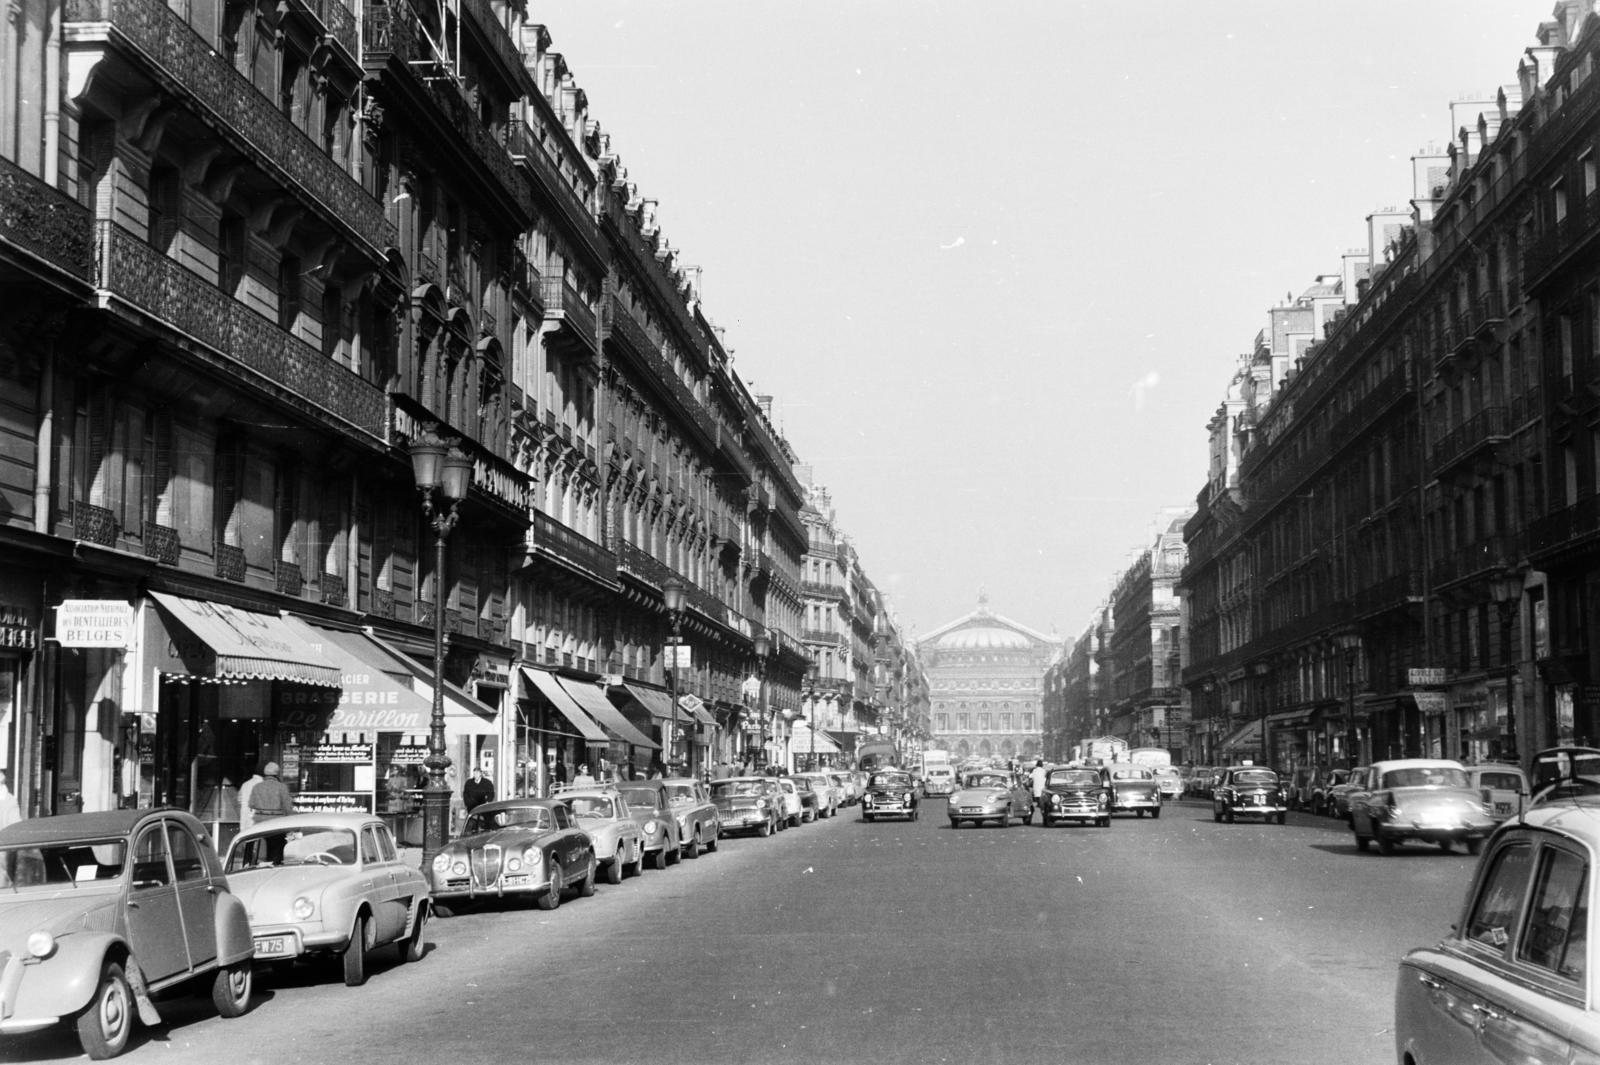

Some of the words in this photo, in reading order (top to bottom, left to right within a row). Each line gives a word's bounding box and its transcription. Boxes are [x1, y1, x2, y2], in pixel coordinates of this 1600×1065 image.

[66, 630, 122, 642] BELGES
[280, 691, 399, 705] BRASSERIE
[278, 709, 317, 728] Le
[328, 708, 420, 727] Carillon
